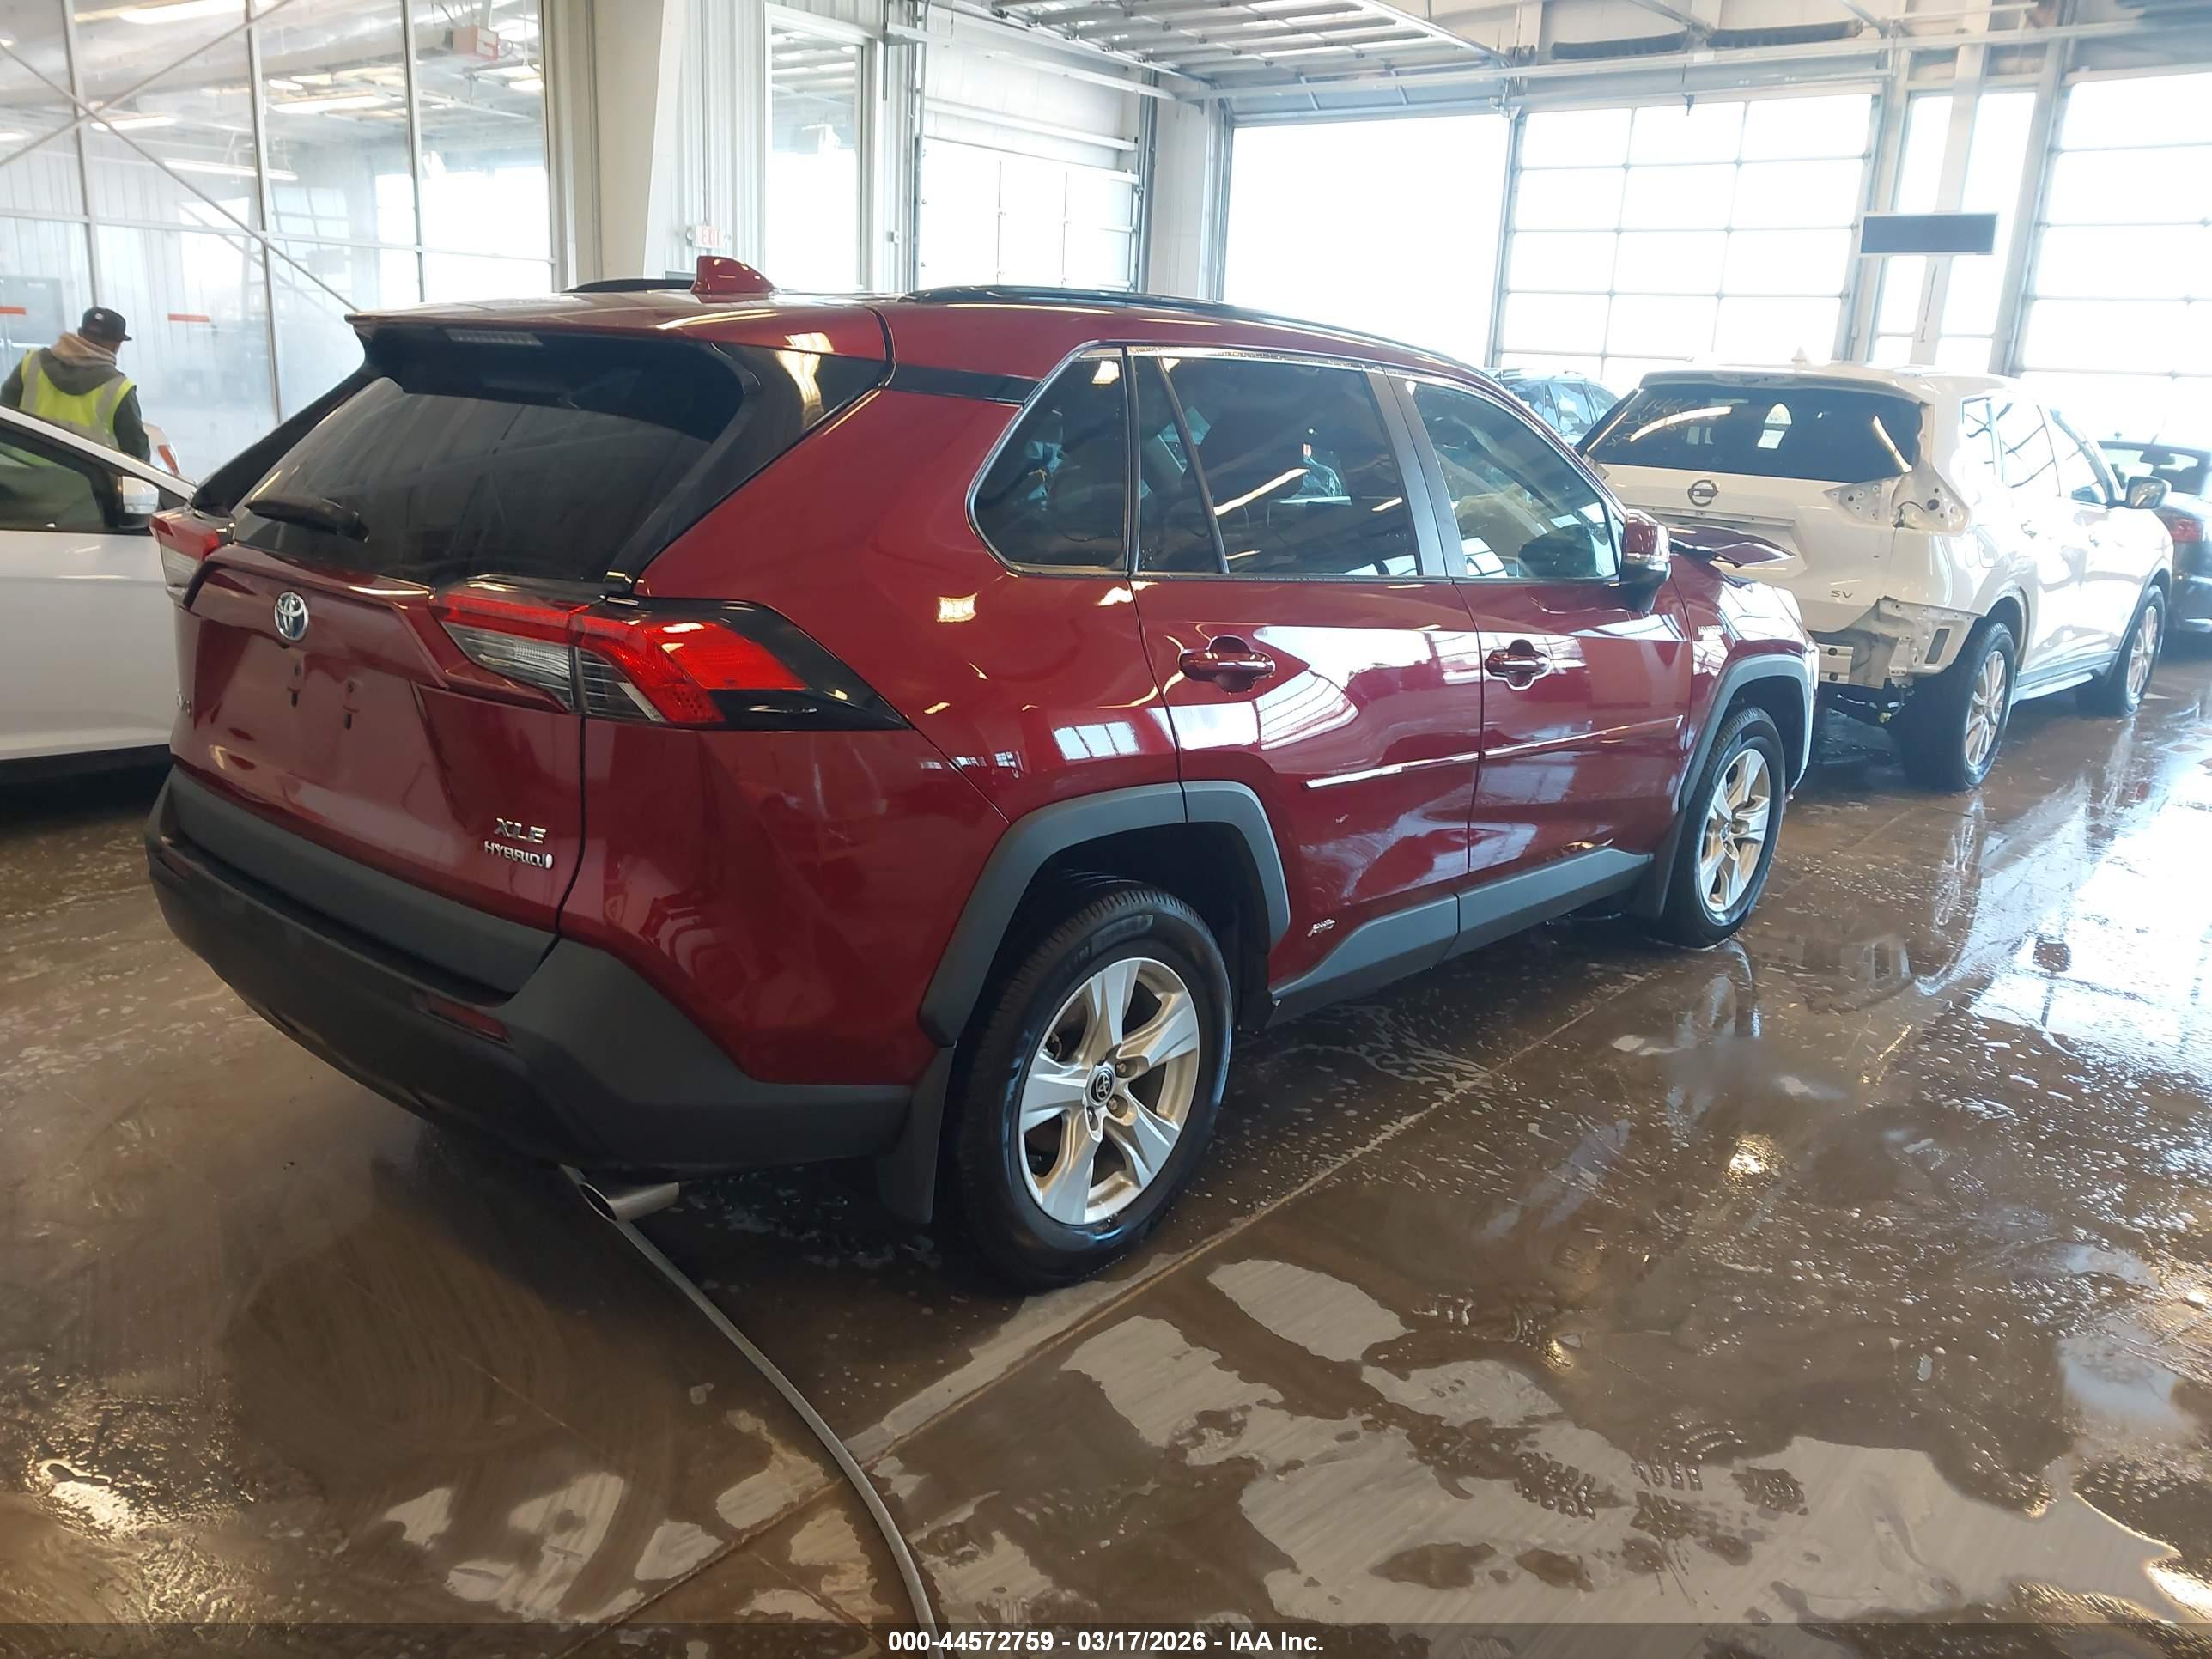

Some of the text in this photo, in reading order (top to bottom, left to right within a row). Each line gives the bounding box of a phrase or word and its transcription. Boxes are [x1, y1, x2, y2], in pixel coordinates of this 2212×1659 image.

[701, 226, 721, 247] EXIT
[1830, 590, 1854, 599] SV
[494, 817, 547, 844] XLE
[484, 840, 544, 868] HYBRID
